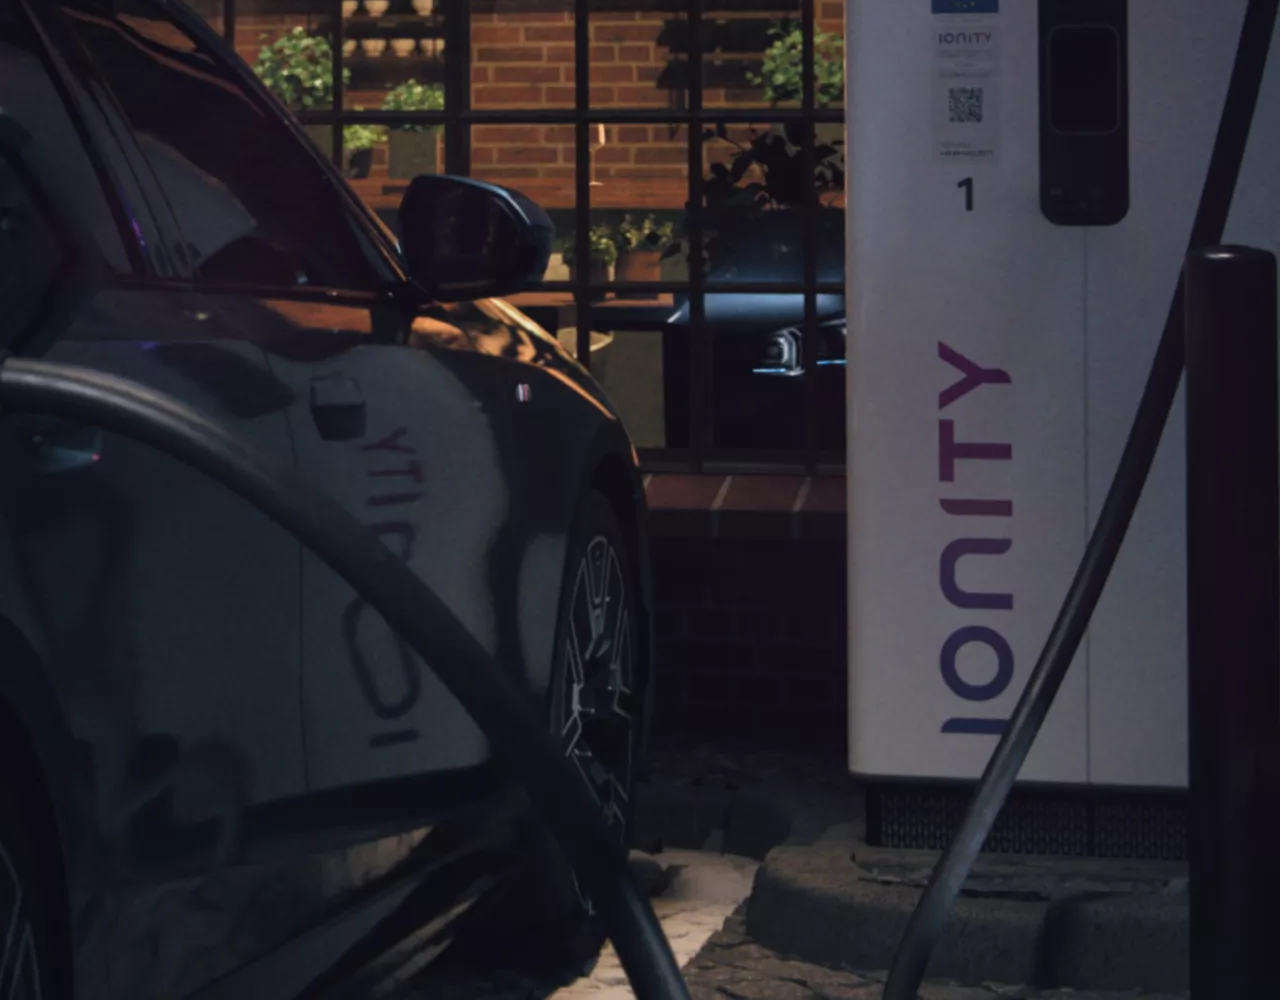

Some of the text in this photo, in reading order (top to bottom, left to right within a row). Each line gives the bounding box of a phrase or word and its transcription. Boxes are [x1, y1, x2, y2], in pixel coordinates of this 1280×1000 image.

[938, 32, 992, 44] IONITY
[956, 176, 974, 212] 1
[938, 340, 1014, 735] IONITY
